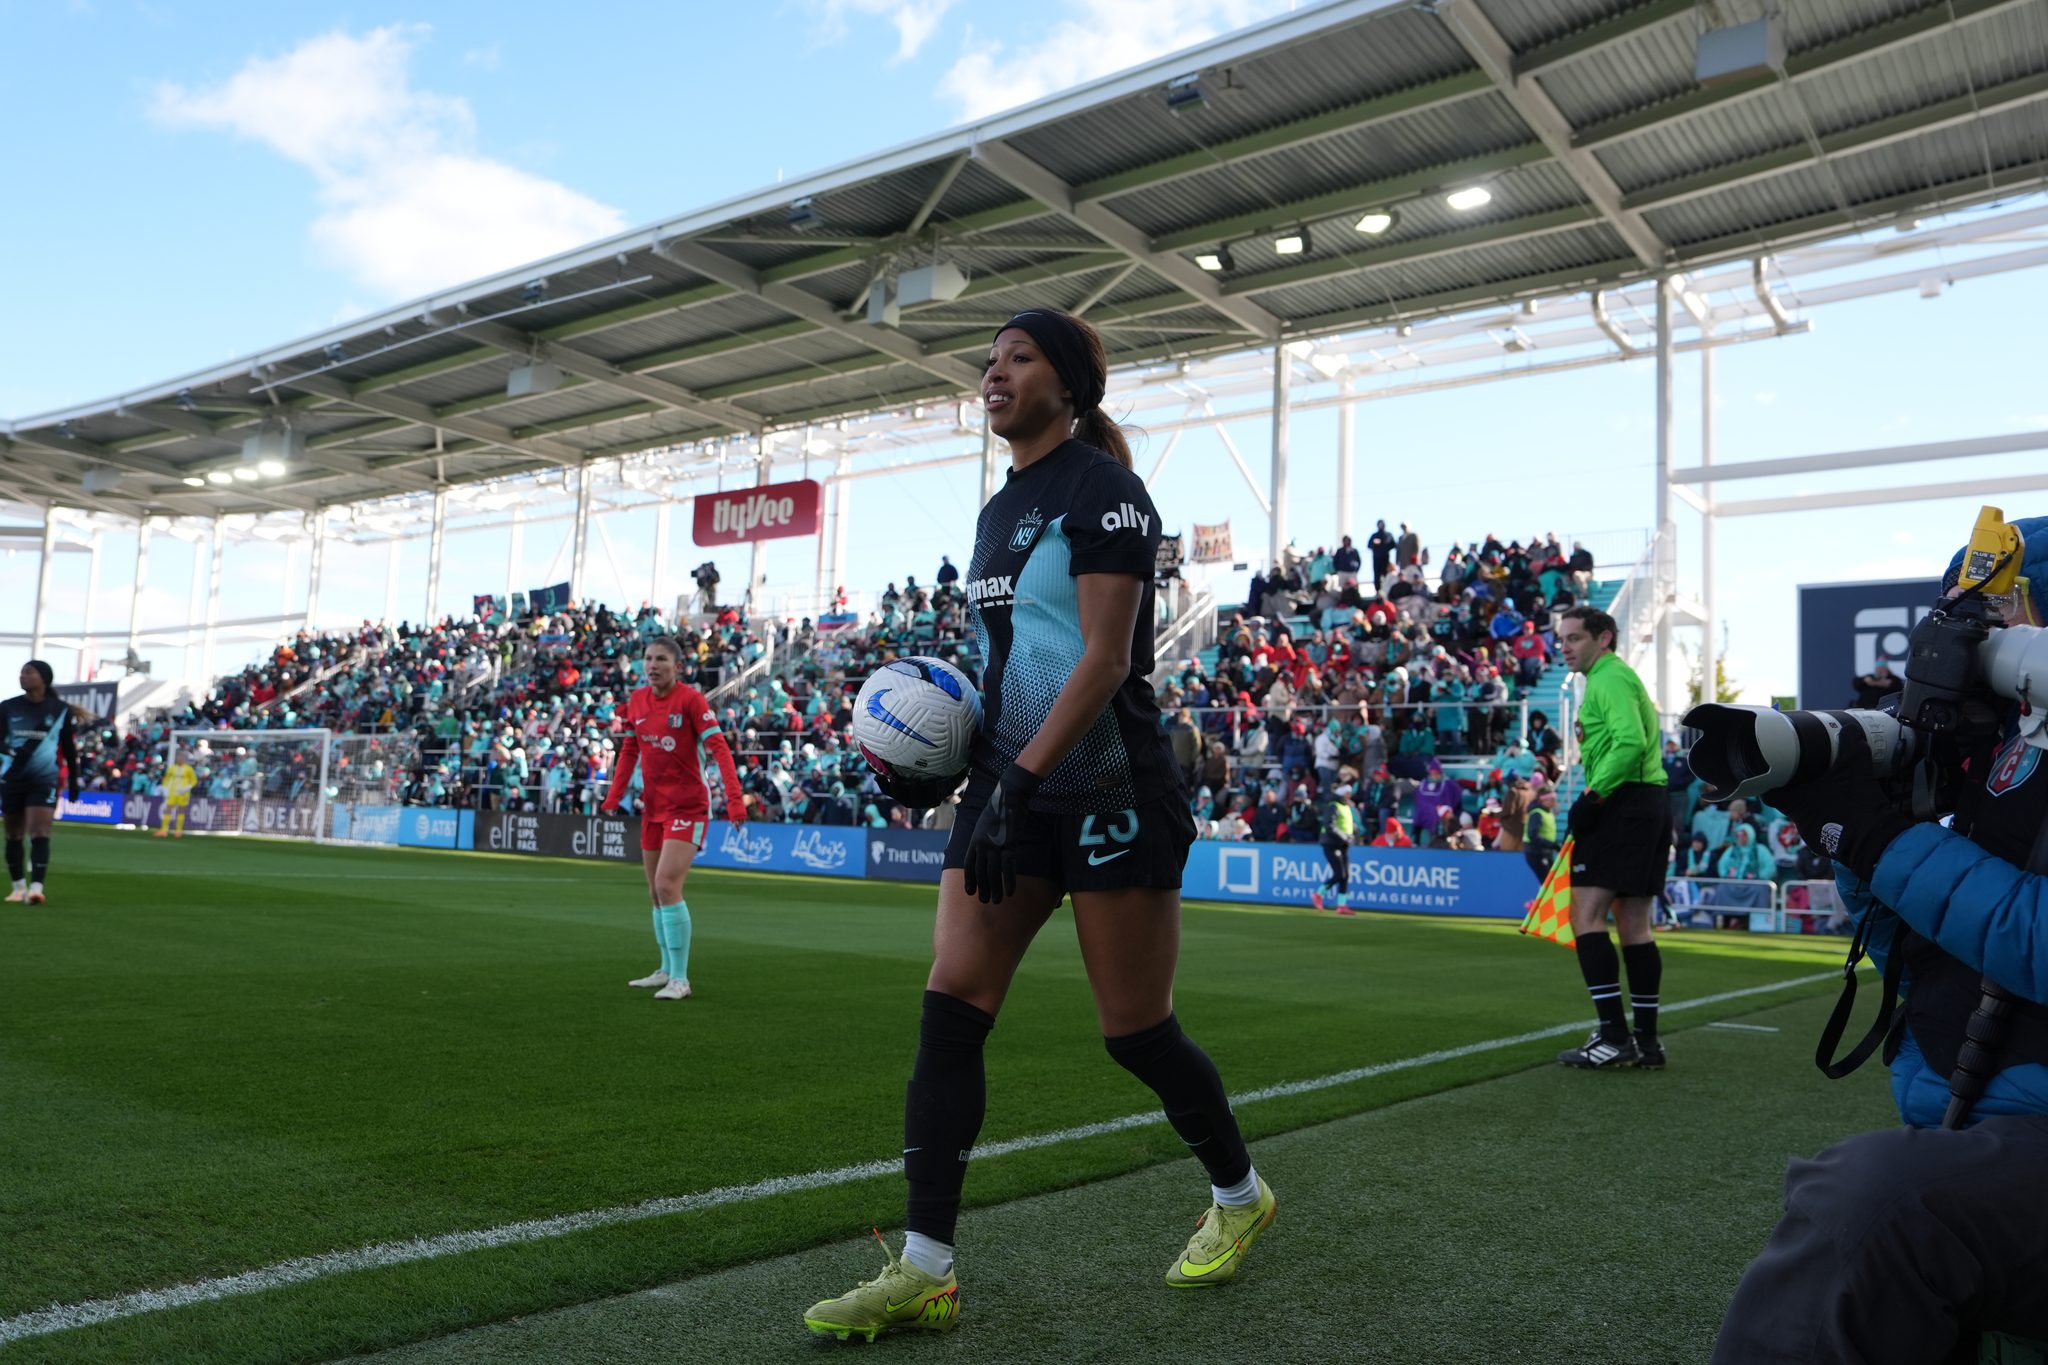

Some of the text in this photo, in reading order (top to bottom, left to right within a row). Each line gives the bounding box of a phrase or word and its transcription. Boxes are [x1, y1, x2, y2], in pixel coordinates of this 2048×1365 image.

[1101, 502, 1150, 537] ally
[1013, 527, 1036, 546] NY
[124, 795, 151, 827] ally
[190, 797, 217, 829] ally
[886, 848, 909, 863] THE
[1272, 856, 1460, 890] PALMR SQUARE
